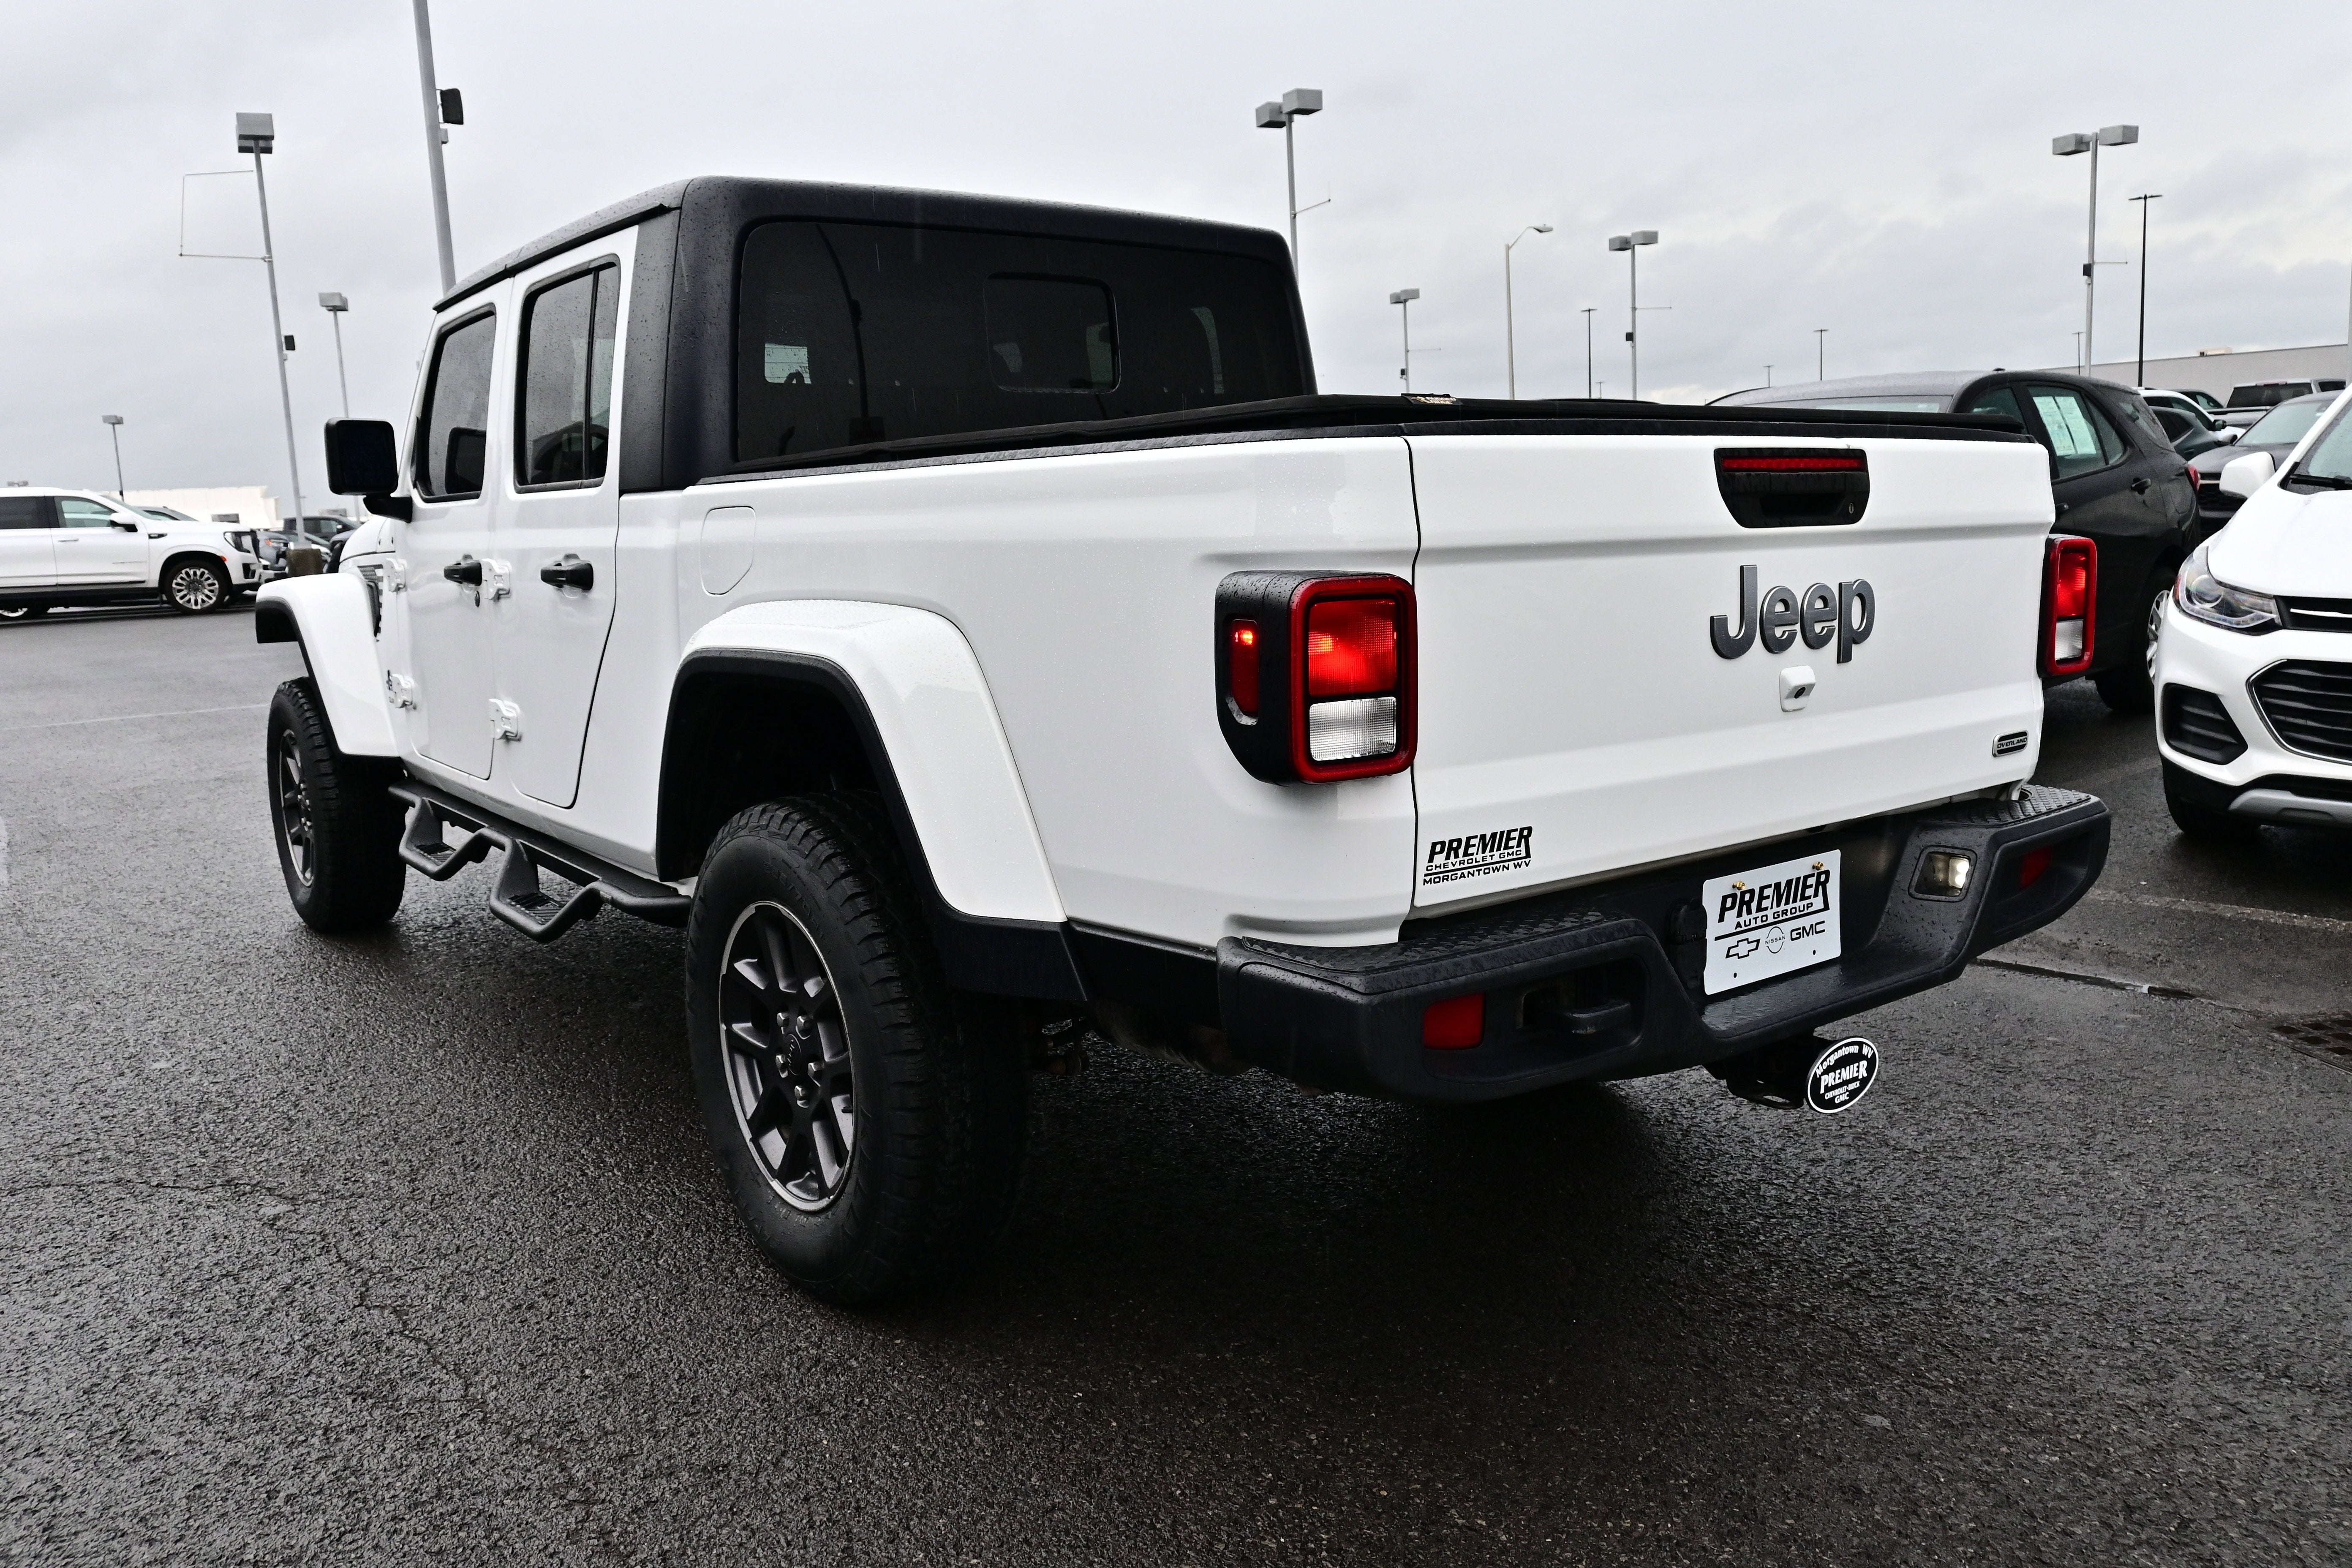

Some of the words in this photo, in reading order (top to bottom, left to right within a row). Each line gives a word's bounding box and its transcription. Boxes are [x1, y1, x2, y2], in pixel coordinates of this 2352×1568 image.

[1710, 564, 1875, 663] Jeep
[1997, 737, 2027, 748] OVERLAND
[1427, 826, 1533, 863] PREMIER
[1423, 864, 1509, 885] MORGANTOWN
[1513, 860, 1531, 869] WV
[1426, 854, 1495, 871] CHEVROLET
[1499, 849, 1522, 859] GMC
[1718, 869, 1830, 923] PREMIER
[1734, 914, 1768, 930] AUTO
[1772, 902, 1813, 920] GROUP
[1765, 935, 1786, 945] NISSAN
[1790, 920, 1825, 941] GMC
[1816, 1045, 1859, 1078] Morgantown
[1862, 1044, 1873, 1059] WV
[1820, 1060, 1867, 1094] PREMIER
[1835, 1092, 1849, 1103] GMC
